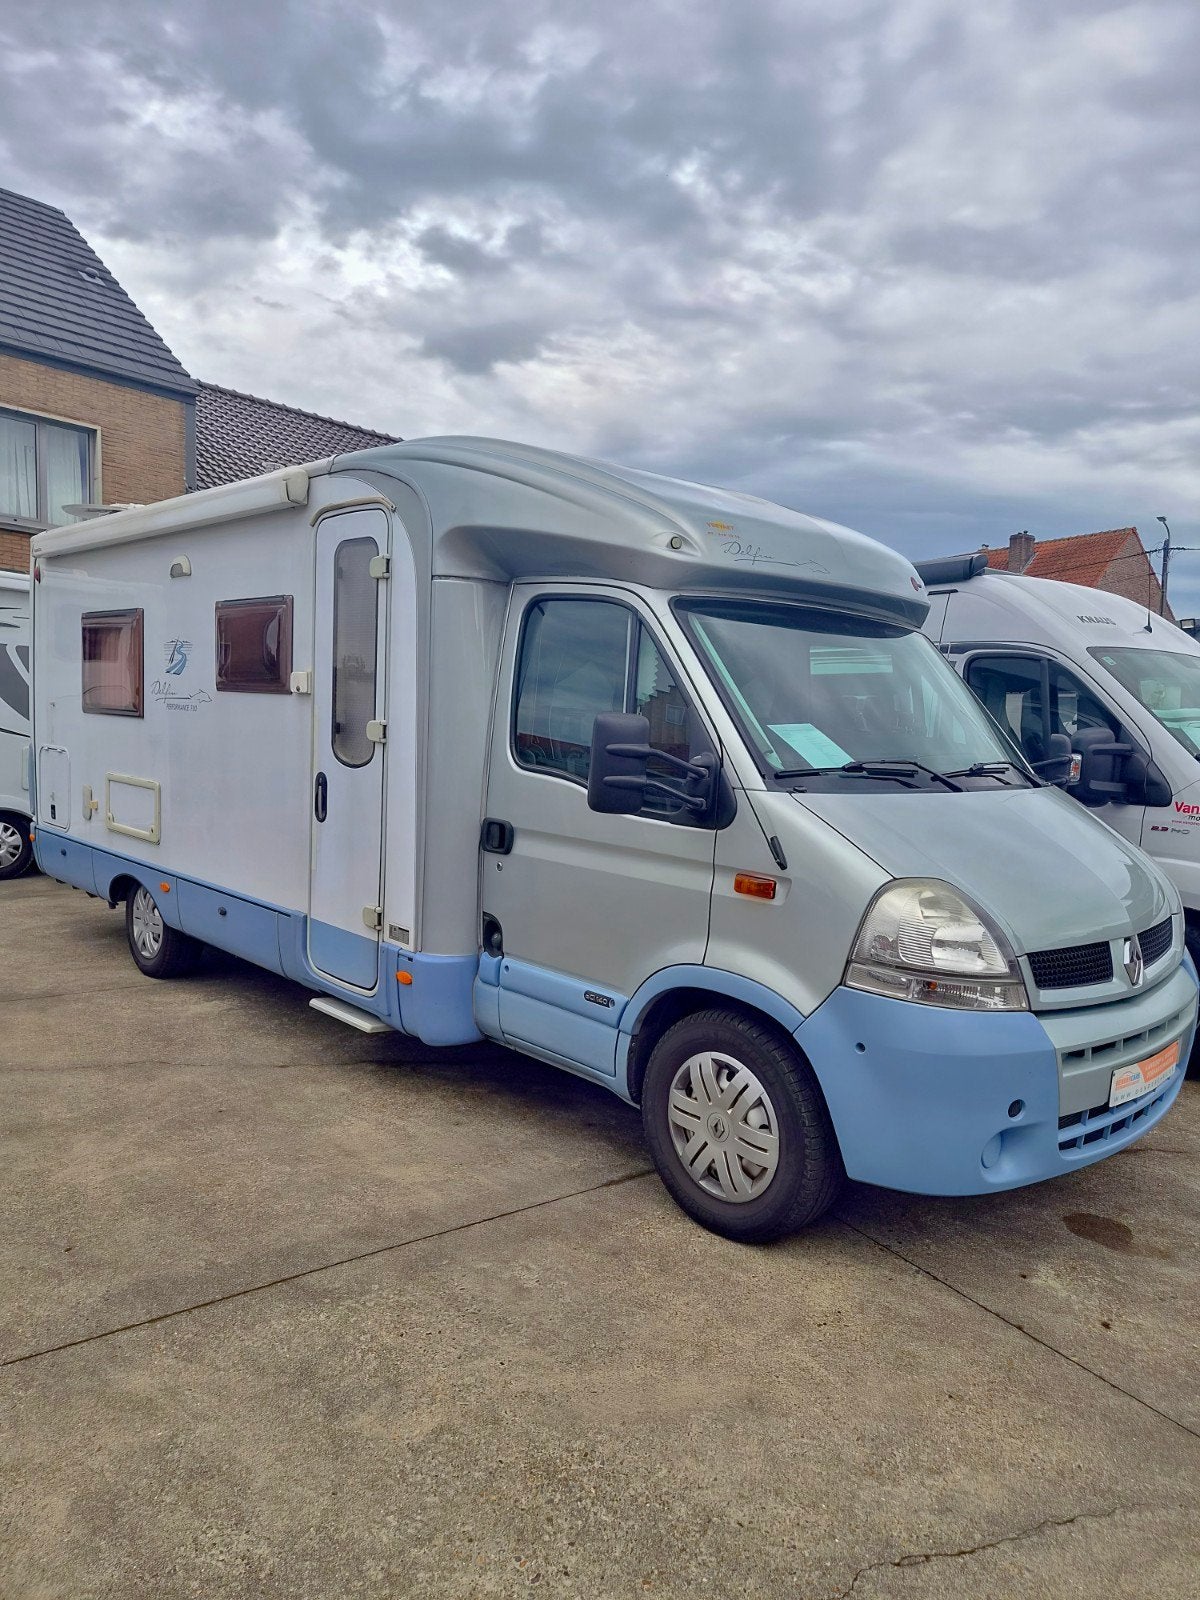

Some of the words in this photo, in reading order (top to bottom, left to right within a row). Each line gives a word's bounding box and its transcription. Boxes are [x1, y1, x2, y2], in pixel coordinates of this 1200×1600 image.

[720, 541, 775, 565] Delfin
[1076, 615, 1116, 625] KNAUS
[166, 703, 190, 712] PERFORMANCE
